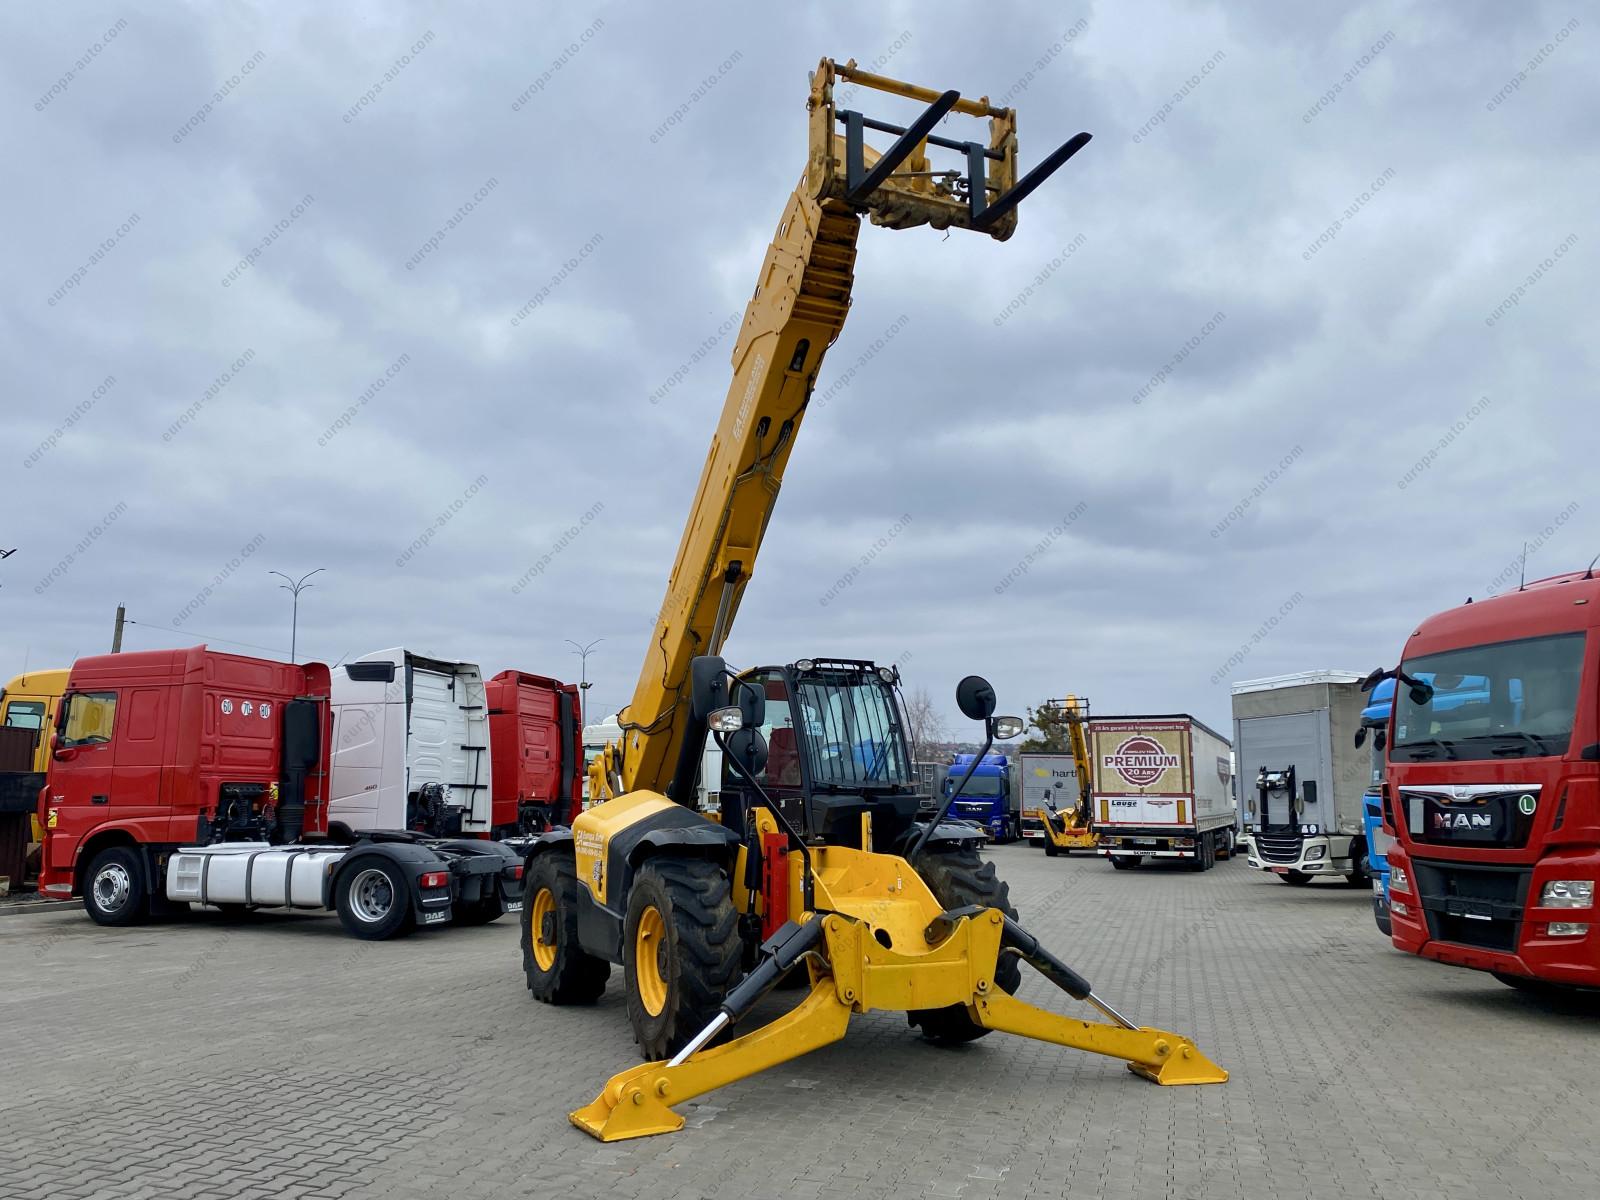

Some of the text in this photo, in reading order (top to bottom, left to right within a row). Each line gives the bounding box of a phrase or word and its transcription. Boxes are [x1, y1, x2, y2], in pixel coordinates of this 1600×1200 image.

[224, 701, 231, 712] 60
[1105, 756, 1178, 767] PREMIUM
[1434, 812, 1491, 829] MAN
[425, 912, 444, 920] DAF
